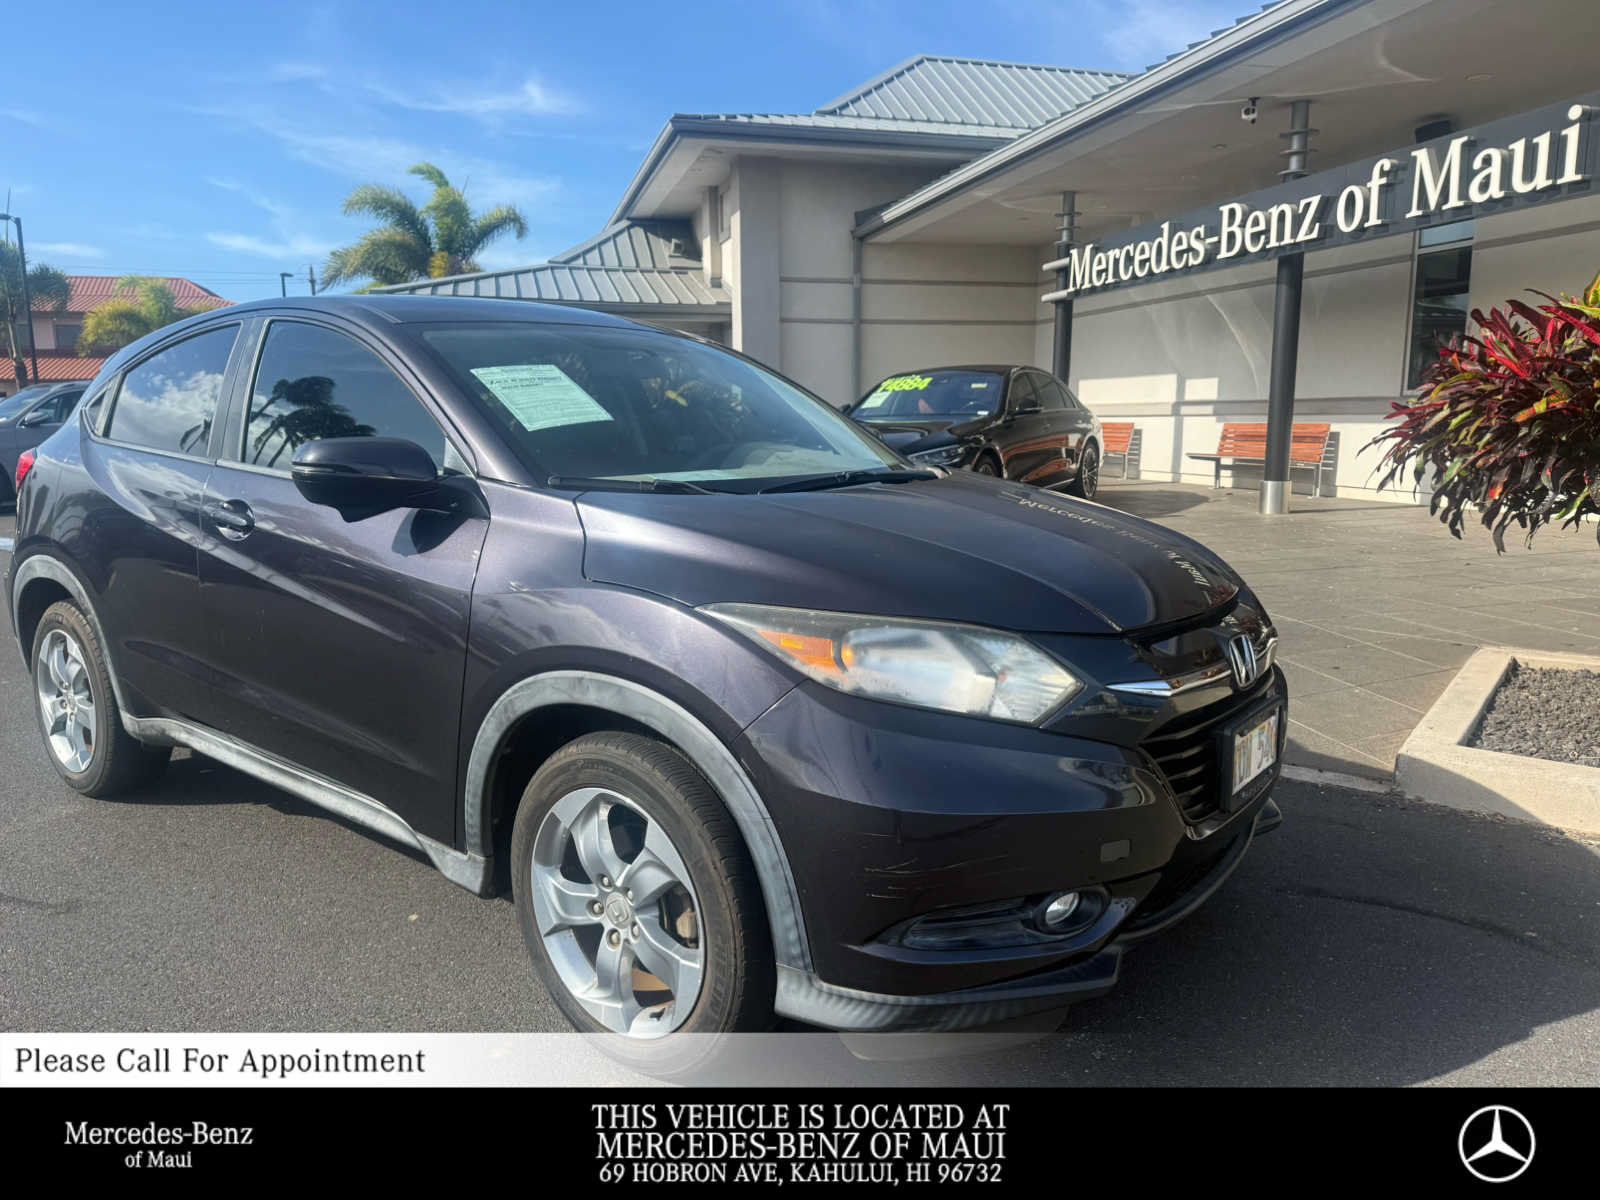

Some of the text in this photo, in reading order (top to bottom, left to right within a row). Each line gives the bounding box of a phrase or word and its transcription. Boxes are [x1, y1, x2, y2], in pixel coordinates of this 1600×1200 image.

[1068, 104, 1583, 292] Mercedes-Benz of Maui
